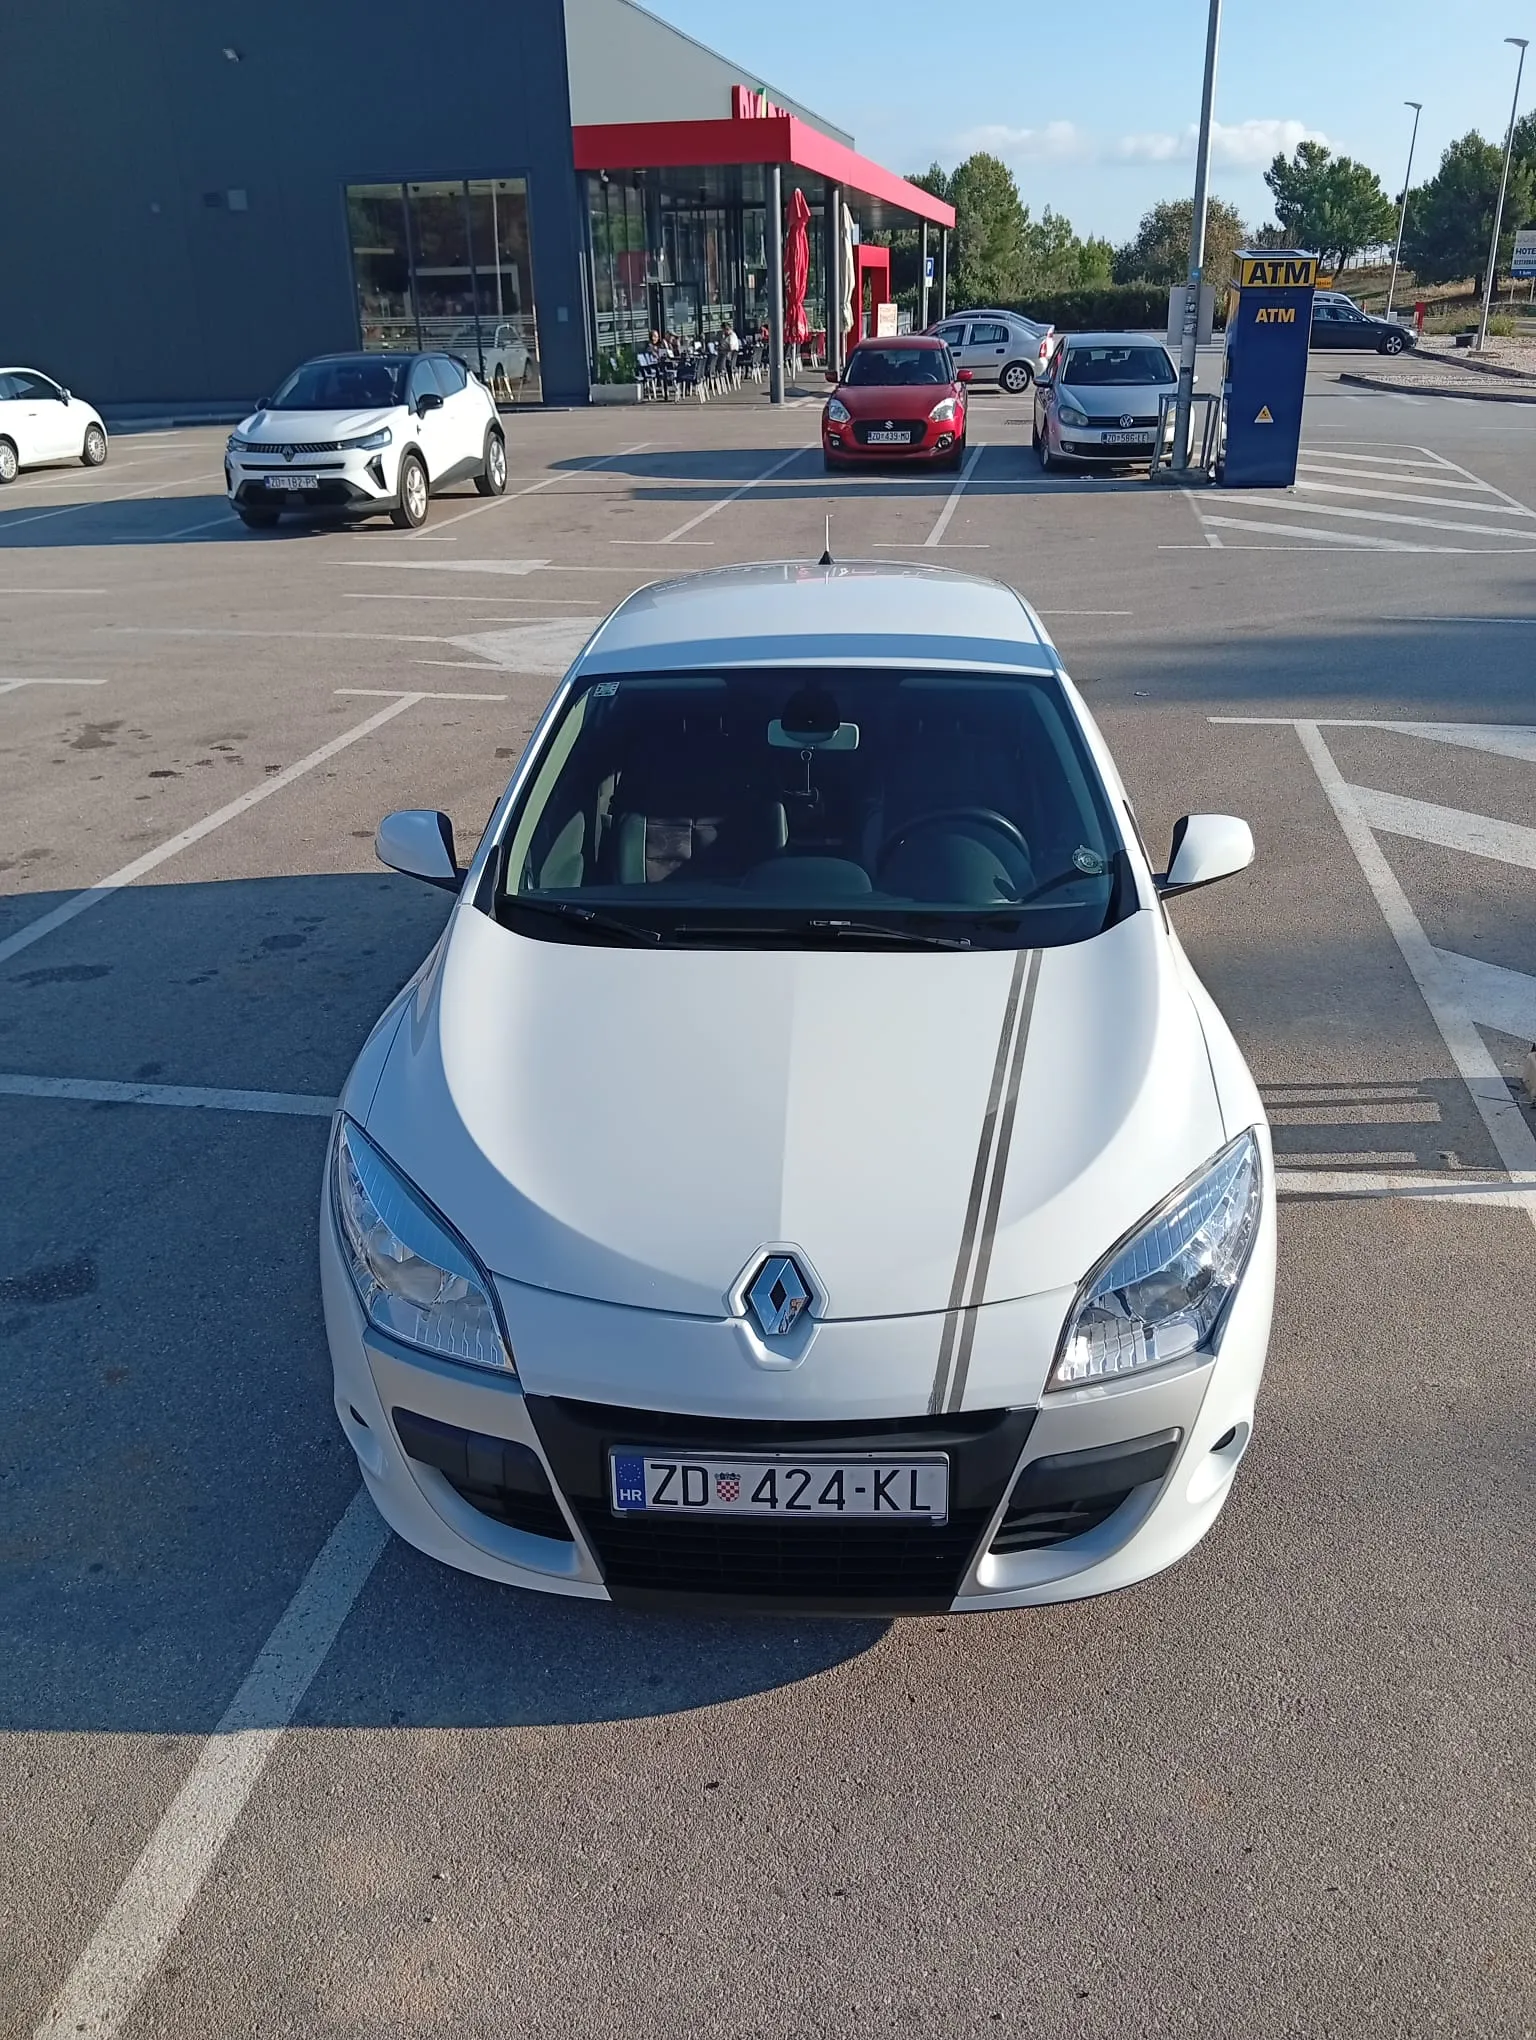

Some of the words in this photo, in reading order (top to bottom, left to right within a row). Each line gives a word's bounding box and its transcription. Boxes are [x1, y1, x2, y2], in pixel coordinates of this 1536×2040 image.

[927, 261, 932, 275] P
[1248, 261, 1311, 285] ATM
[1255, 308, 1296, 323] ATM
[872, 432, 881, 441] ZD
[1107, 434, 1117, 442] ZD
[271, 477, 281, 488] ZD
[649, 1463, 709, 1507] ZD
[751, 1468, 931, 1511] 424-KL
[619, 1488, 643, 1502] HR
